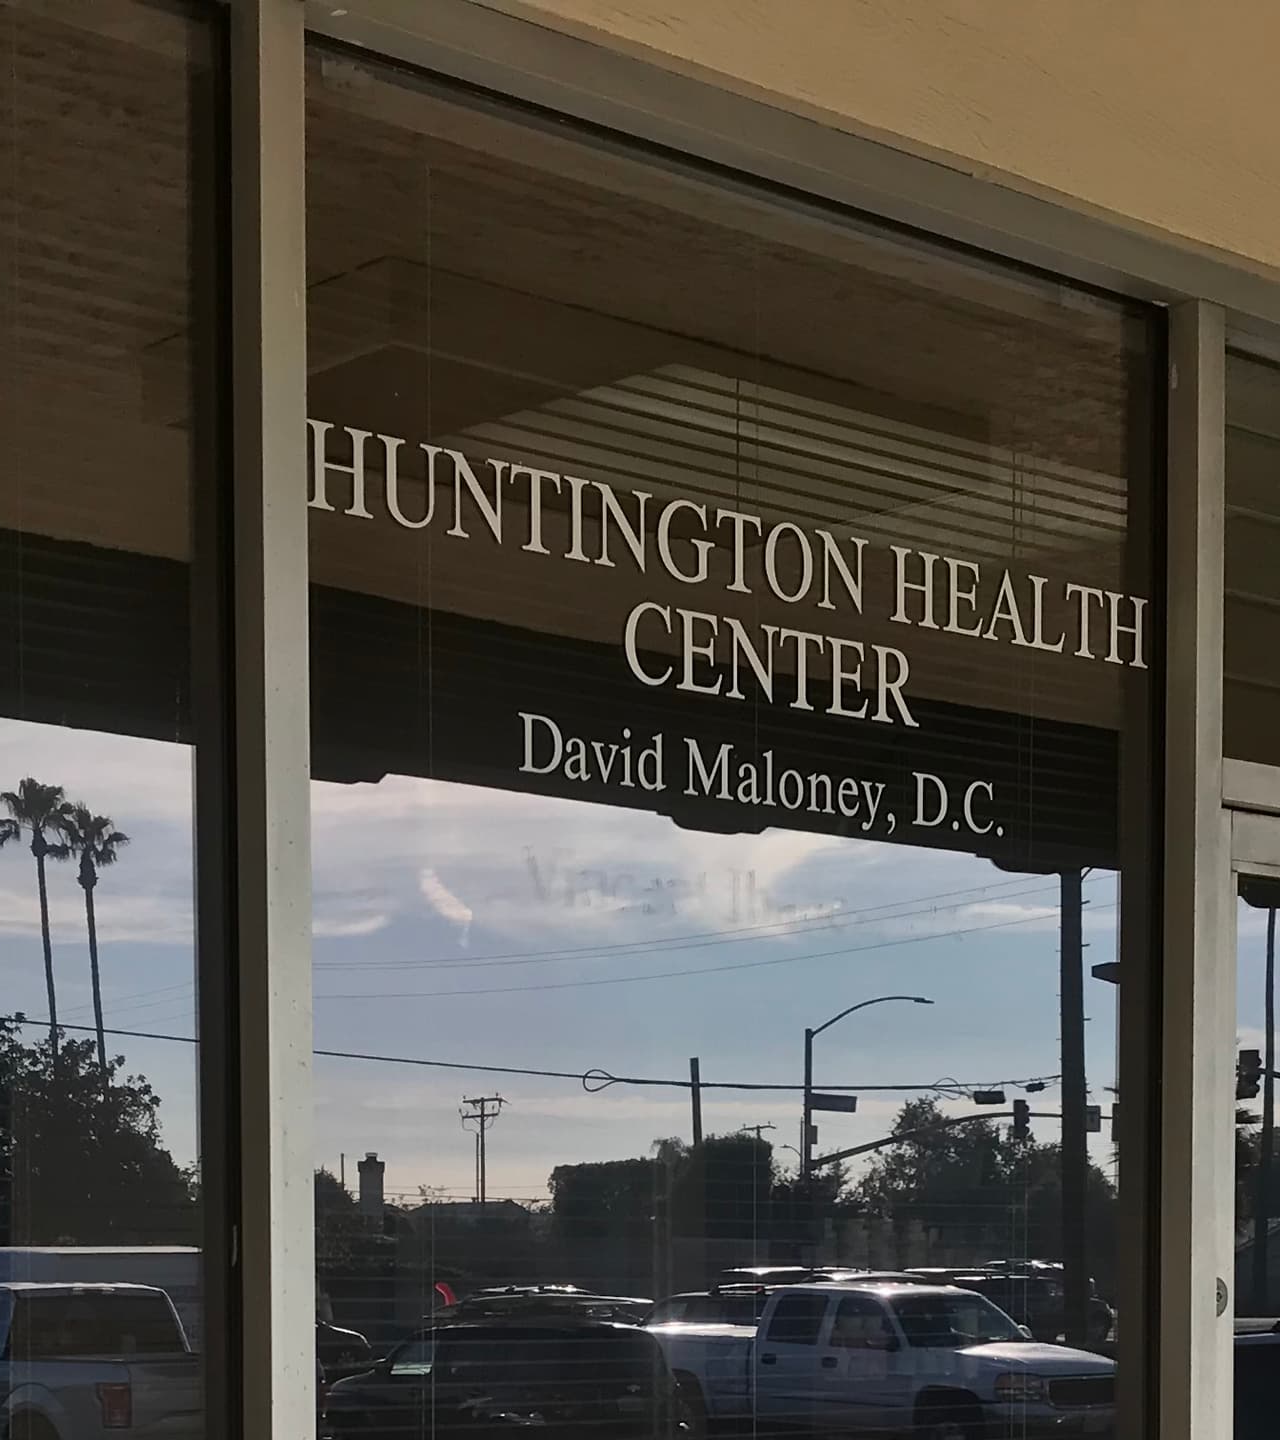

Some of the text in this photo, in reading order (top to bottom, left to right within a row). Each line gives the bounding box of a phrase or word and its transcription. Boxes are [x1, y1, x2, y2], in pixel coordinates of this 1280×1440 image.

[307, 420, 1150, 670] HUNTINGTON HEALTH
[625, 602, 920, 728] CENTER
[519, 712, 1006, 838] David Maloney, D.C.
